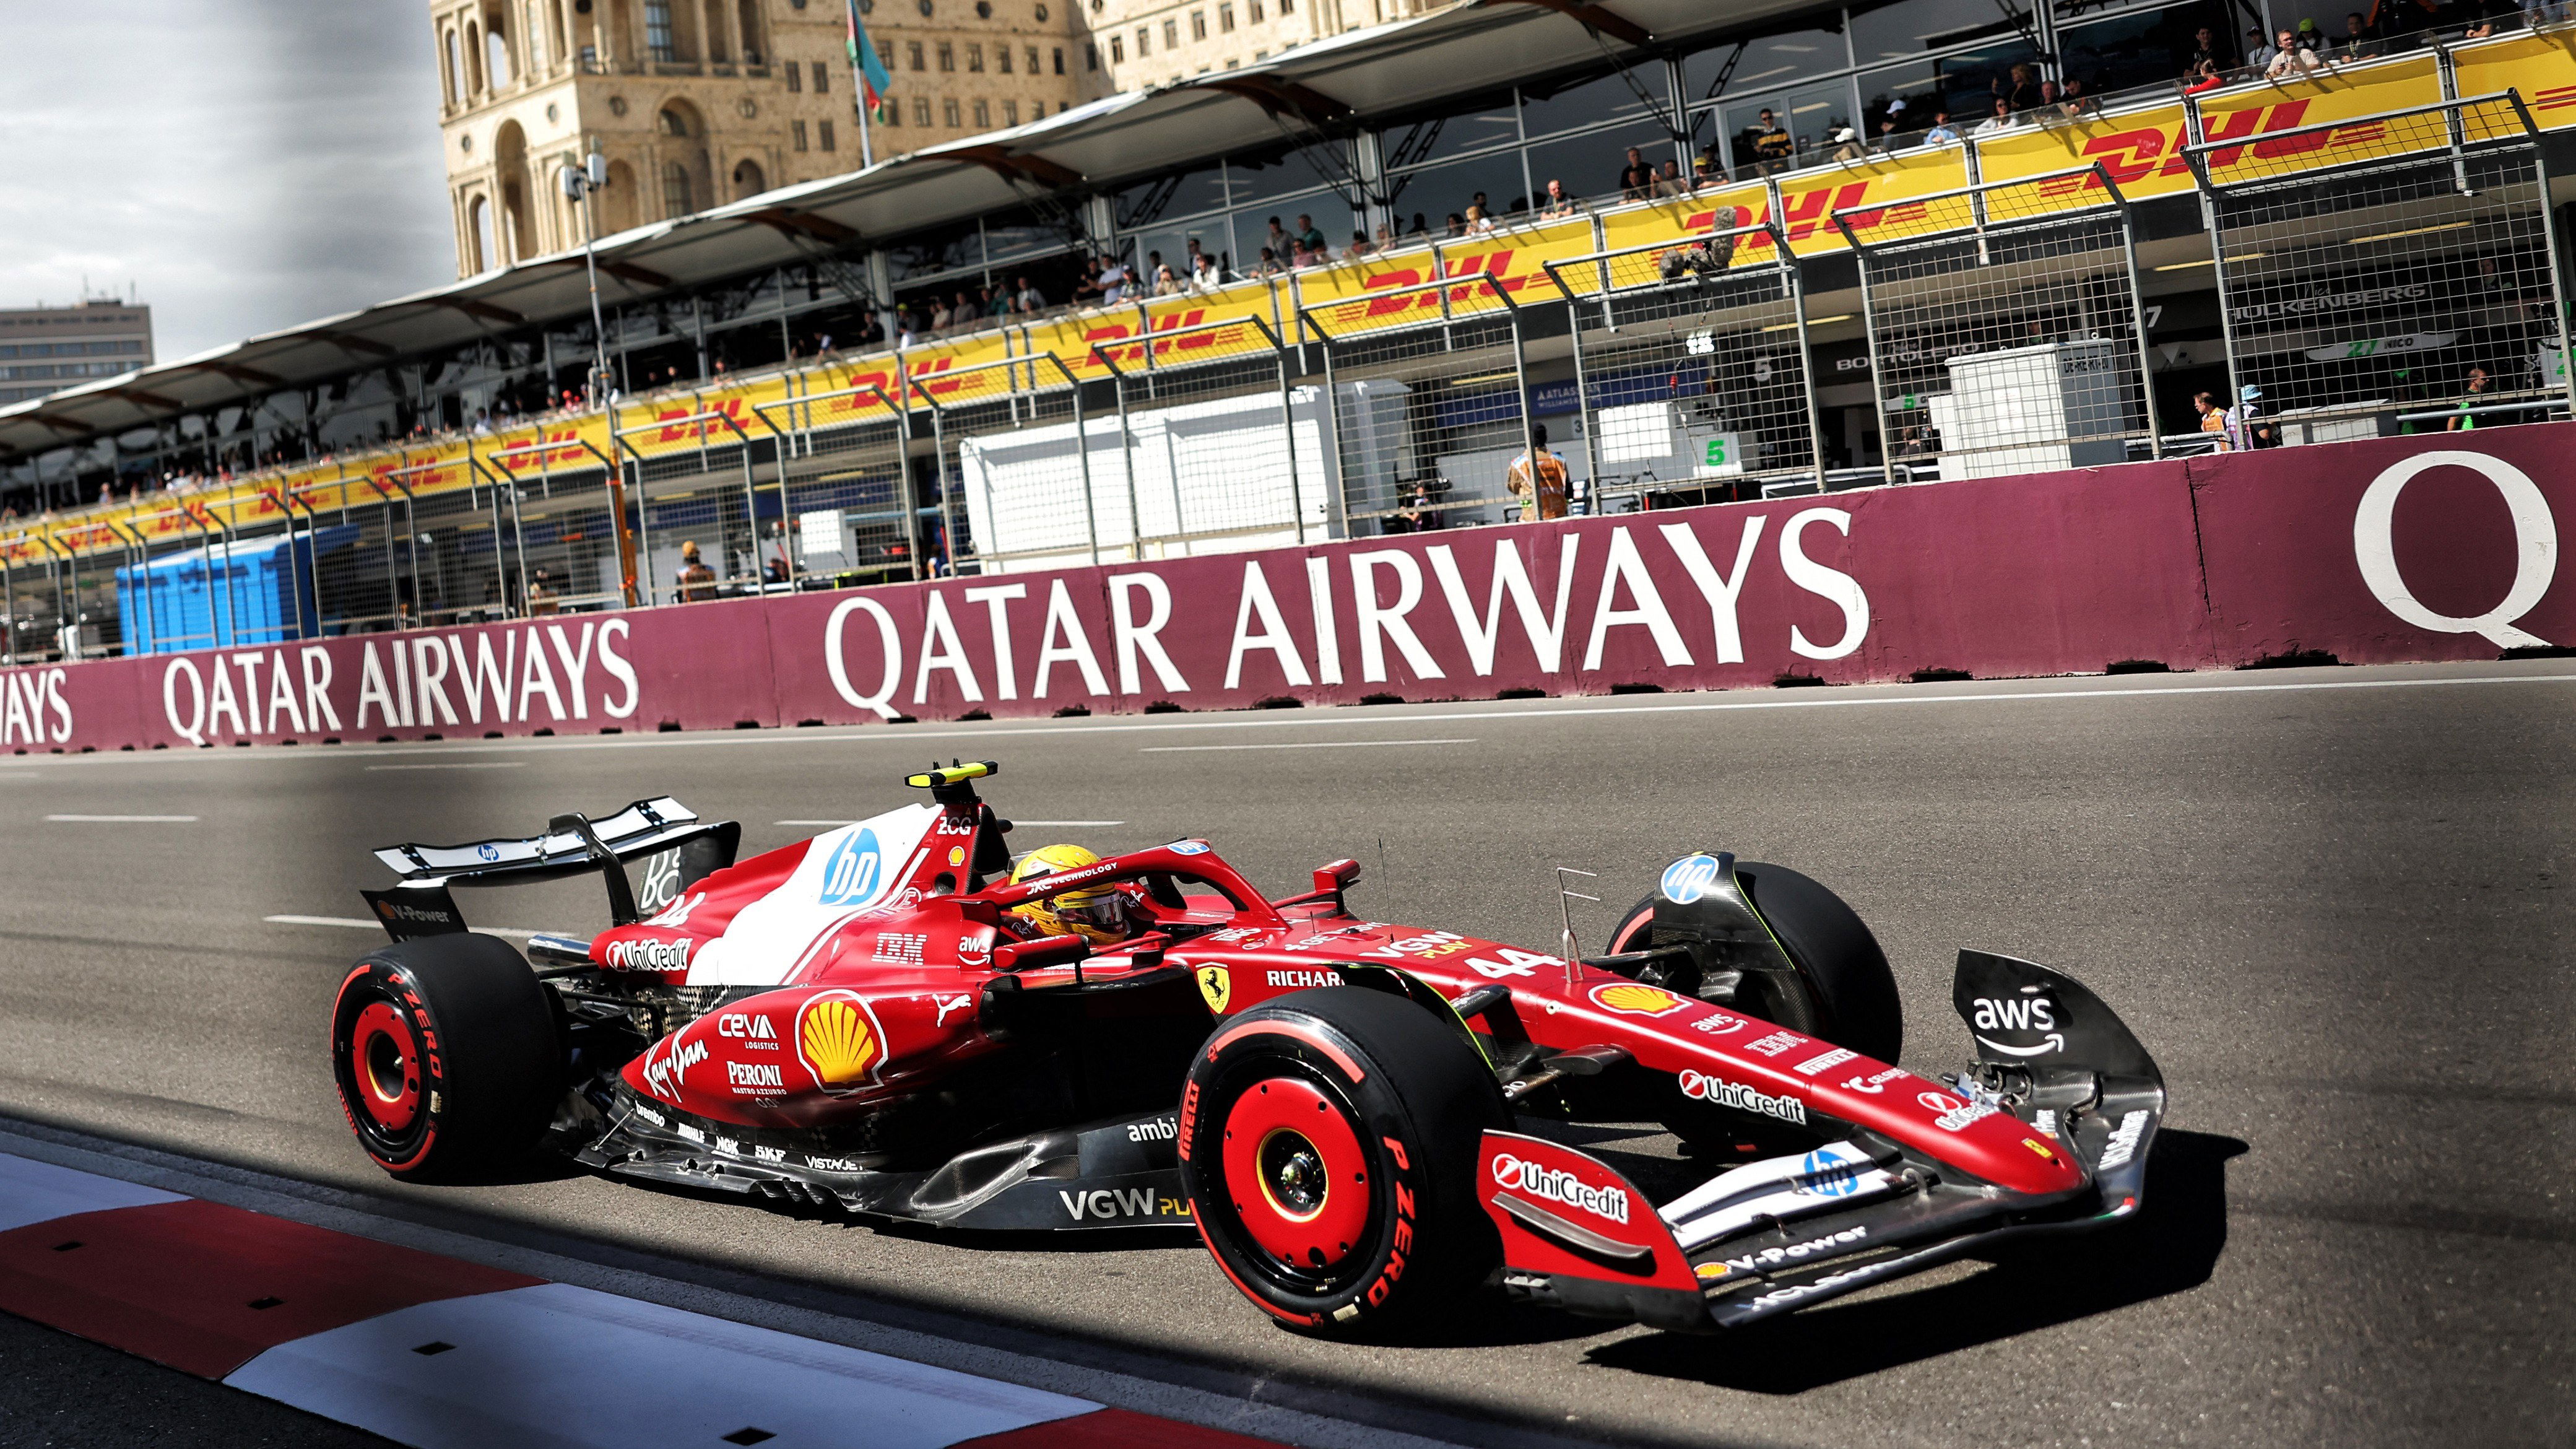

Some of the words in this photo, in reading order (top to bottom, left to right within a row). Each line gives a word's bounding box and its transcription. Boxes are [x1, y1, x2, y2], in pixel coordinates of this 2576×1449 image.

[2081, 98, 2333, 189] DHL
[1365, 251, 1527, 316] DHL
[1085, 310, 1217, 367] DHL
[2348, 340, 2379, 357] 27
[2384, 337, 2414, 349] NICO
[1753, 355, 1772, 382] 5
[1836, 341, 1980, 372] BOTOLETO
[851, 357, 963, 408] DHL
[1904, 393, 1915, 409] 5
[659, 399, 750, 443] DHL
[505, 430, 584, 470] DHL
[1706, 440, 1725, 466] 5
[374, 457, 443, 491] DHL
[824, 572, 1191, 720] QATAR
[1224, 507, 1870, 689] AIRWAYS
[163, 646, 342, 746] QATAR
[357, 619, 639, 729] AIRWAYS
[0, 668, 72, 744] AYS
[937, 816, 971, 835] ZCG
[479, 845, 499, 861] hp
[1171, 842, 1209, 855] hp
[820, 828, 879, 905] hp
[1055, 862, 1117, 886] TECHNOLOGY
[1663, 855, 1717, 904] hp
[391, 904, 449, 923] V-Power
[624, 938, 692, 971] UniCredit
[871, 933, 928, 965] IBM
[959, 936, 991, 953] aws
[1358, 931, 1464, 958] VGW
[1413, 941, 1473, 959] PLAY
[1464, 948, 1566, 978] 44
[1267, 970, 1345, 987] RICHAR
[388, 973, 404, 985] P
[403, 989, 442, 1079] ZERO
[719, 1013, 778, 1040] CEVA
[1691, 1014, 1734, 1032] aws
[1974, 998, 2055, 1030] aws
[745, 1041, 779, 1051] LOGISTICS
[1744, 1031, 1809, 1056] IBM
[727, 1061, 783, 1086] PERONI
[1793, 1048, 1858, 1076] PIRELLI
[635, 1100, 665, 1128] brembo
[1704, 1075, 1806, 1125] UniCredit
[677, 1122, 705, 1144] MAHLE
[1127, 1116, 1177, 1142] ambi
[1179, 1079, 1200, 1161] PIRELLI
[716, 1136, 739, 1155] NGK
[755, 1145, 786, 1162] SKF
[1384, 1136, 1410, 1171] P
[1807, 1151, 1856, 1196] hp
[1059, 1188, 1154, 1221] VGW
[1159, 1198, 1190, 1216] PL
[1522, 1162, 1628, 1225] UniCredit
[1367, 1181, 1416, 1308] ZERO
[1725, 1225, 1867, 1271] V-Power
